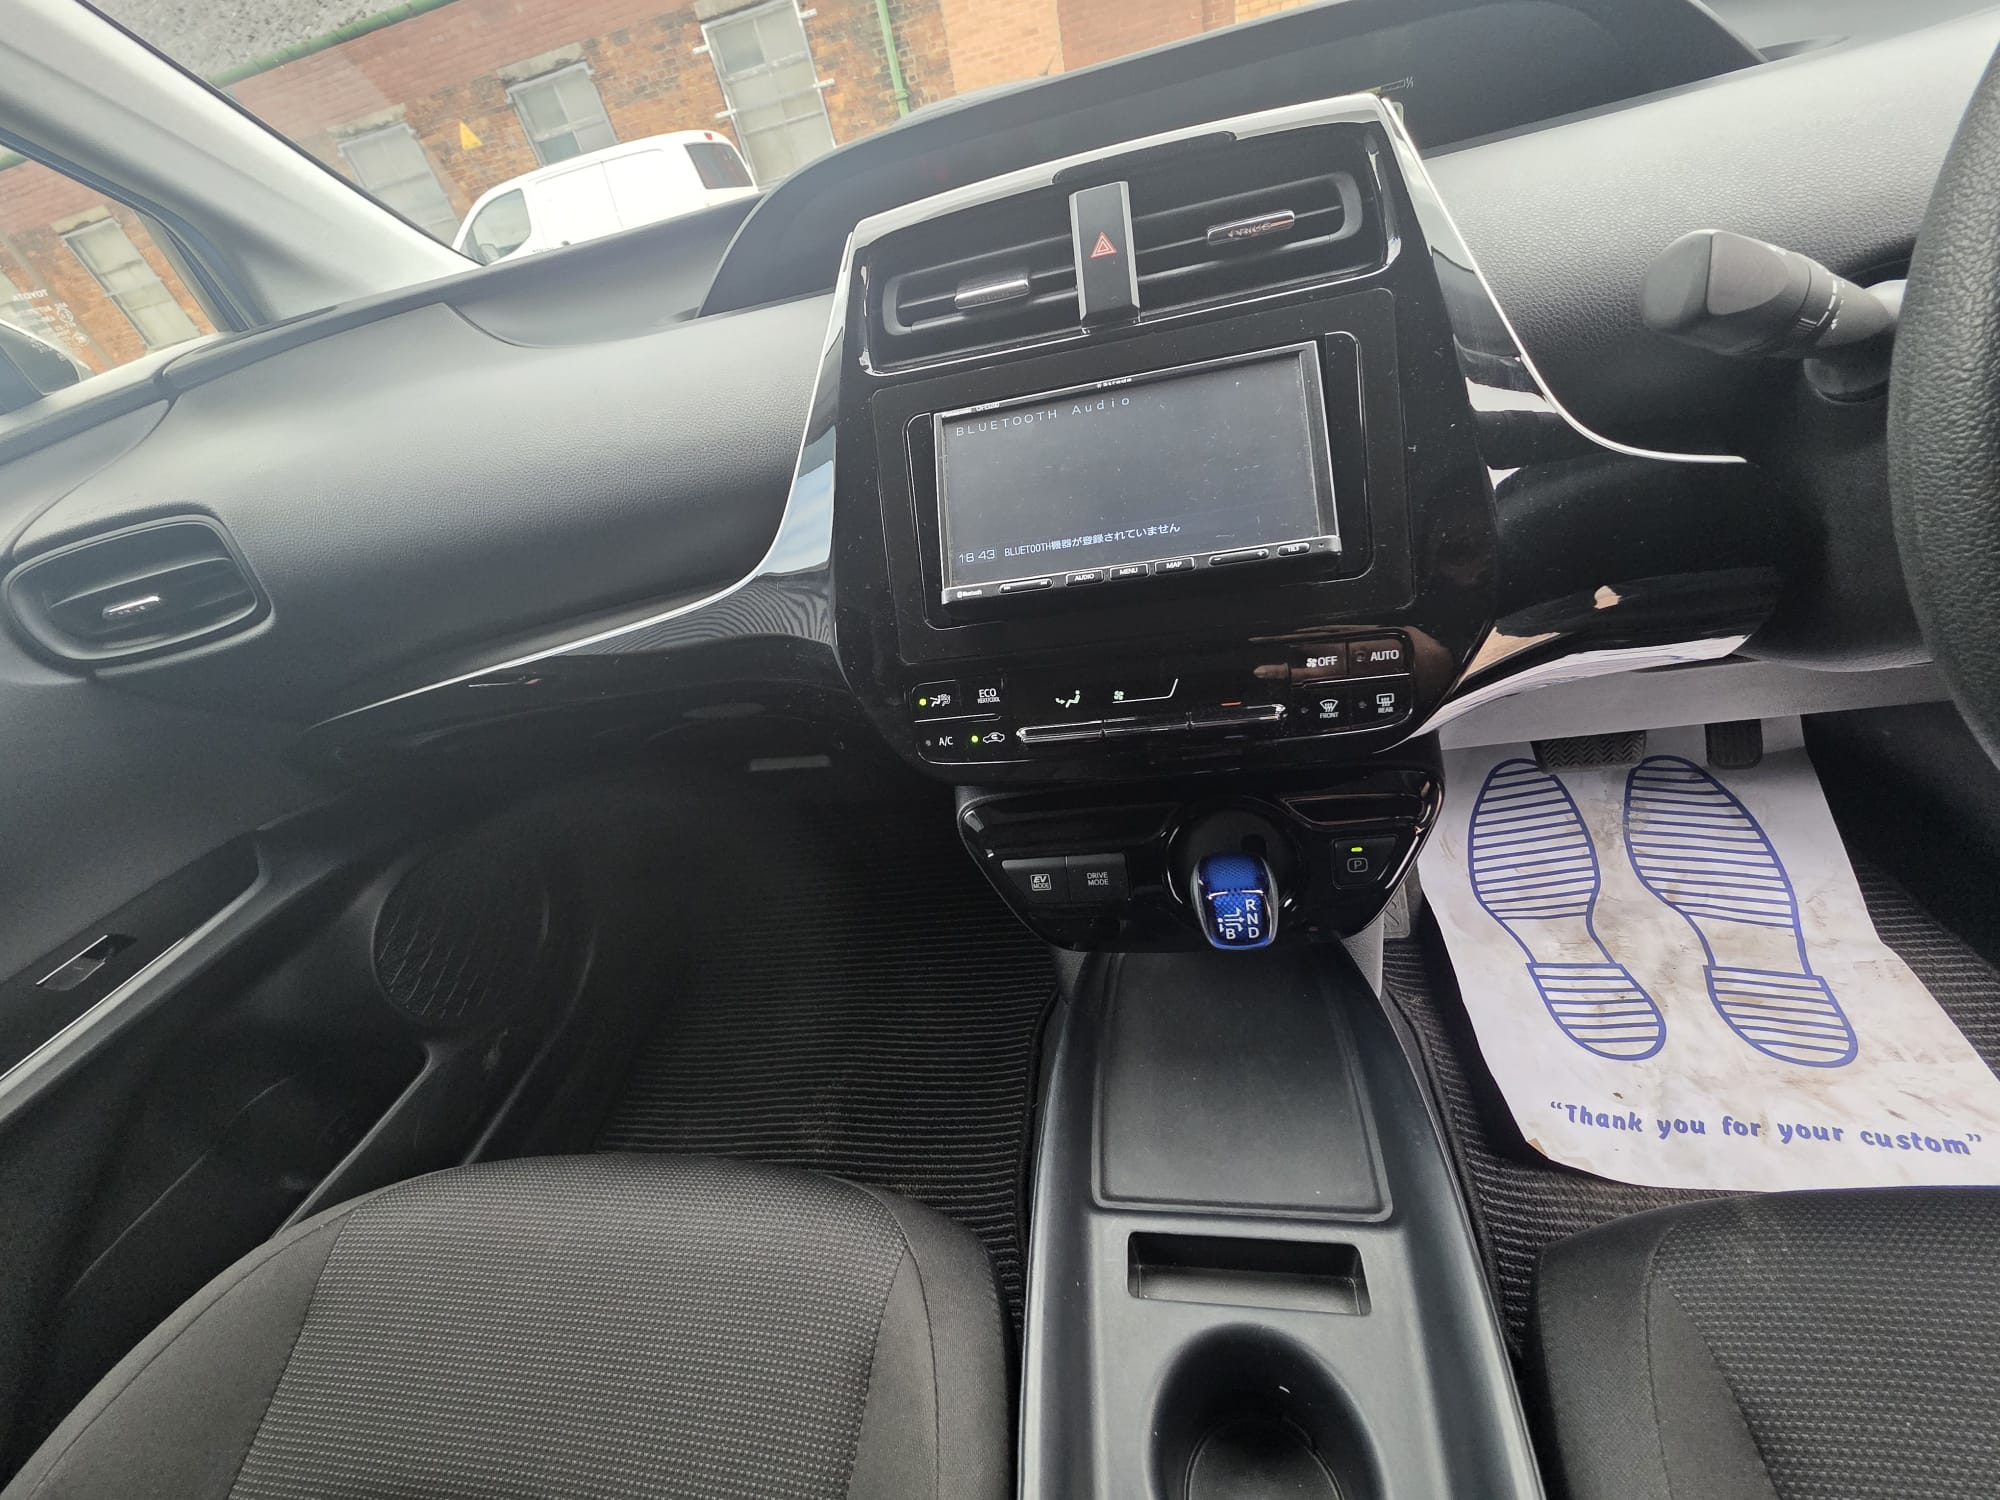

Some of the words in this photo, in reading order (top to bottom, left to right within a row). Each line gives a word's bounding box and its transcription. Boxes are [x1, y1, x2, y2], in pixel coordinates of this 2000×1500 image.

[956, 409, 1058, 436] BLUETOOTH
[1072, 397, 1130, 415] Audio
[1166, 560, 1183, 569] MAP
[1074, 572, 1095, 582] AUDIO
[1119, 567, 1139, 576] MENU
[1317, 655, 1338, 667] OFF
[1370, 649, 1400, 662] AUTO
[979, 687, 997, 698] ECO
[1377, 706, 1394, 714] REAR
[939, 735, 953, 747] A/C
[1353, 860, 1362, 870] P
[1033, 875, 1047, 883] EV
[1086, 872, 1108, 880] DRIVE
[1245, 899, 1257, 911] R
[1246, 913, 1259, 925] N
[1225, 928, 1237, 940] B
[1248, 926, 1260, 939] D
[1656, 1118, 1706, 1140] you
[1722, 1115, 1761, 1137] for
[1777, 1123, 1844, 1144] your
